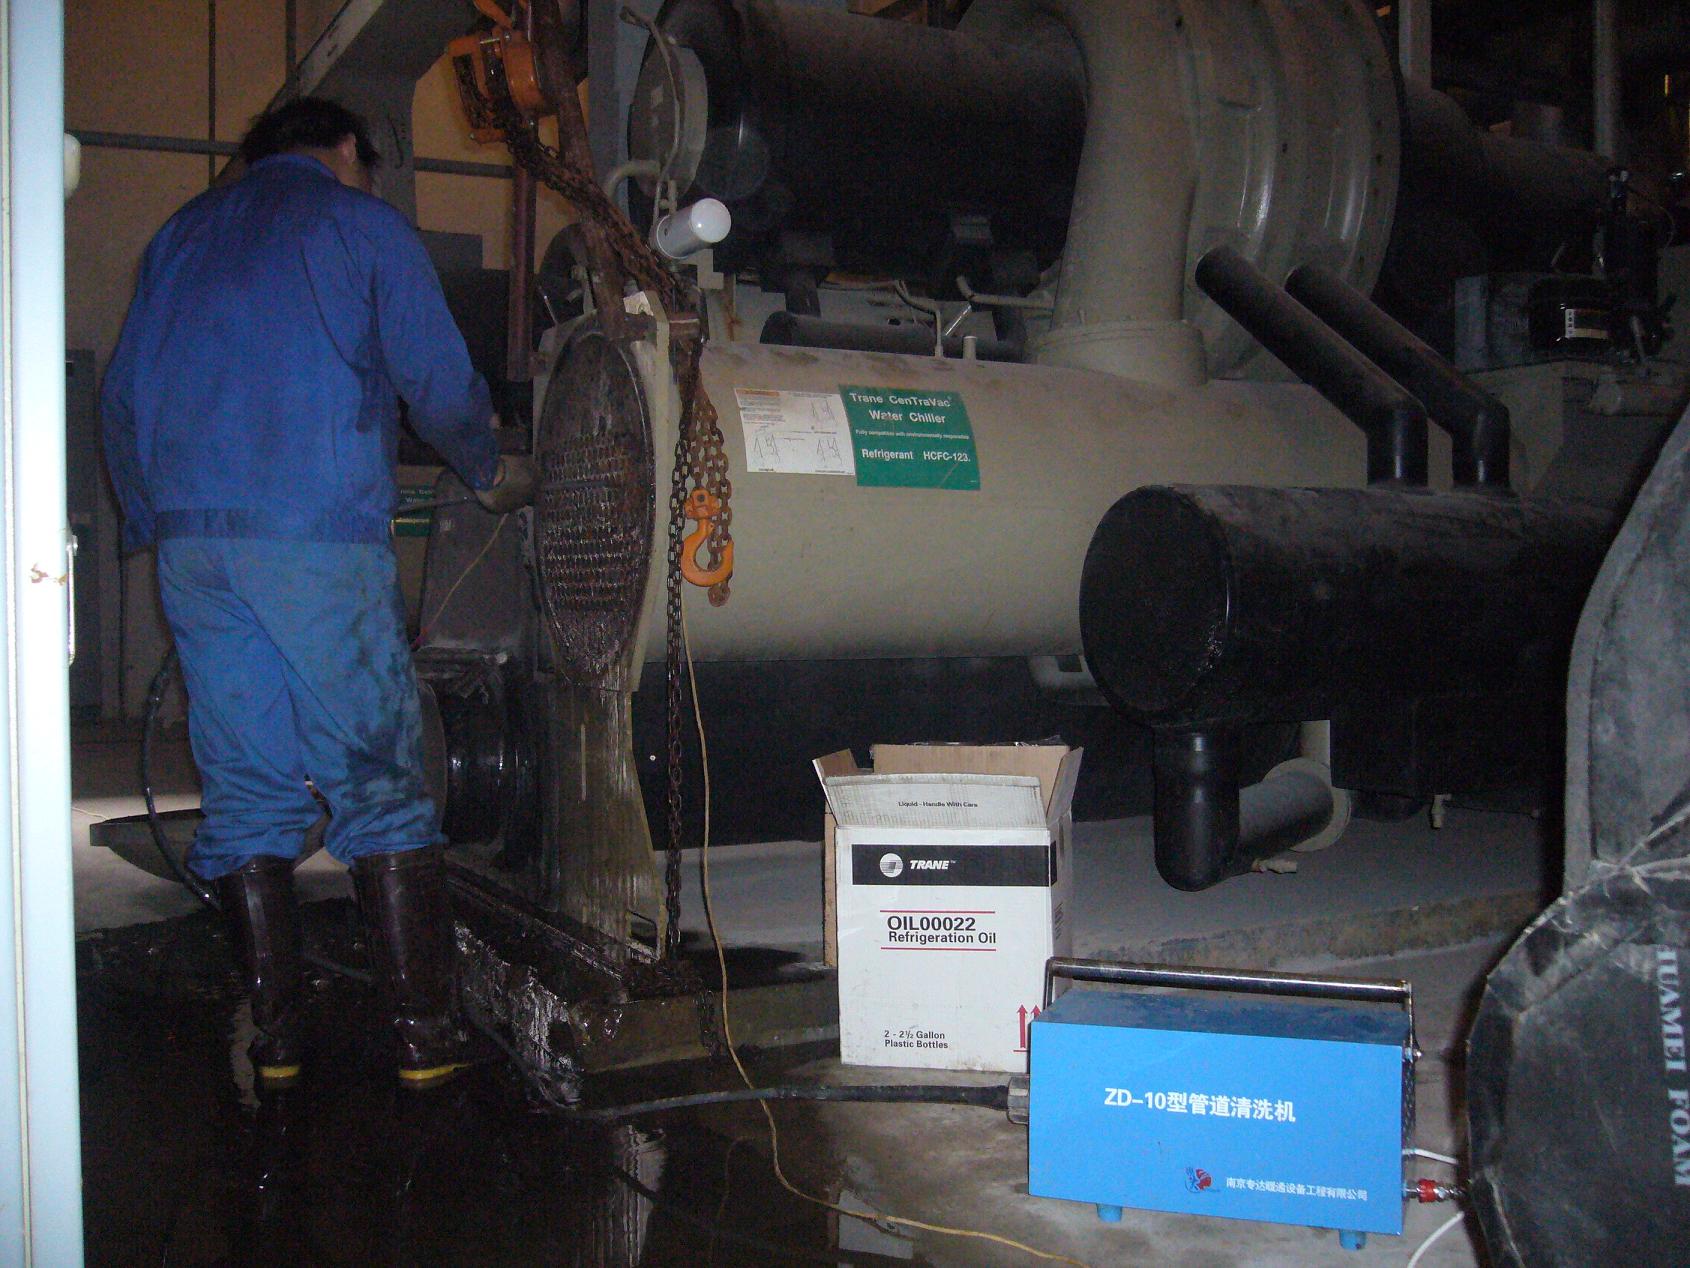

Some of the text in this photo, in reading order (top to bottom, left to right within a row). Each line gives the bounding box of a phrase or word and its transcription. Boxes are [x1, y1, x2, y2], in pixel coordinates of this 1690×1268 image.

[849, 392, 883, 403] Trane
[868, 409, 946, 424] Water Chiller
[861, 449, 913, 461] Refrigerant
[909, 860, 950, 870] TRANE
[887, 915, 976, 931] OIL00022
[888, 931, 996, 945] Refrigeration Oil
[884, 1030, 890, 1038] 2
[916, 1030, 945, 1039] Gallon
[884, 1040, 949, 1049] Plastic Bottles
[1104, 1087, 1296, 1123] ZD-10型管道清洗机
[1667, 1087, 1690, 1186] FOAM
